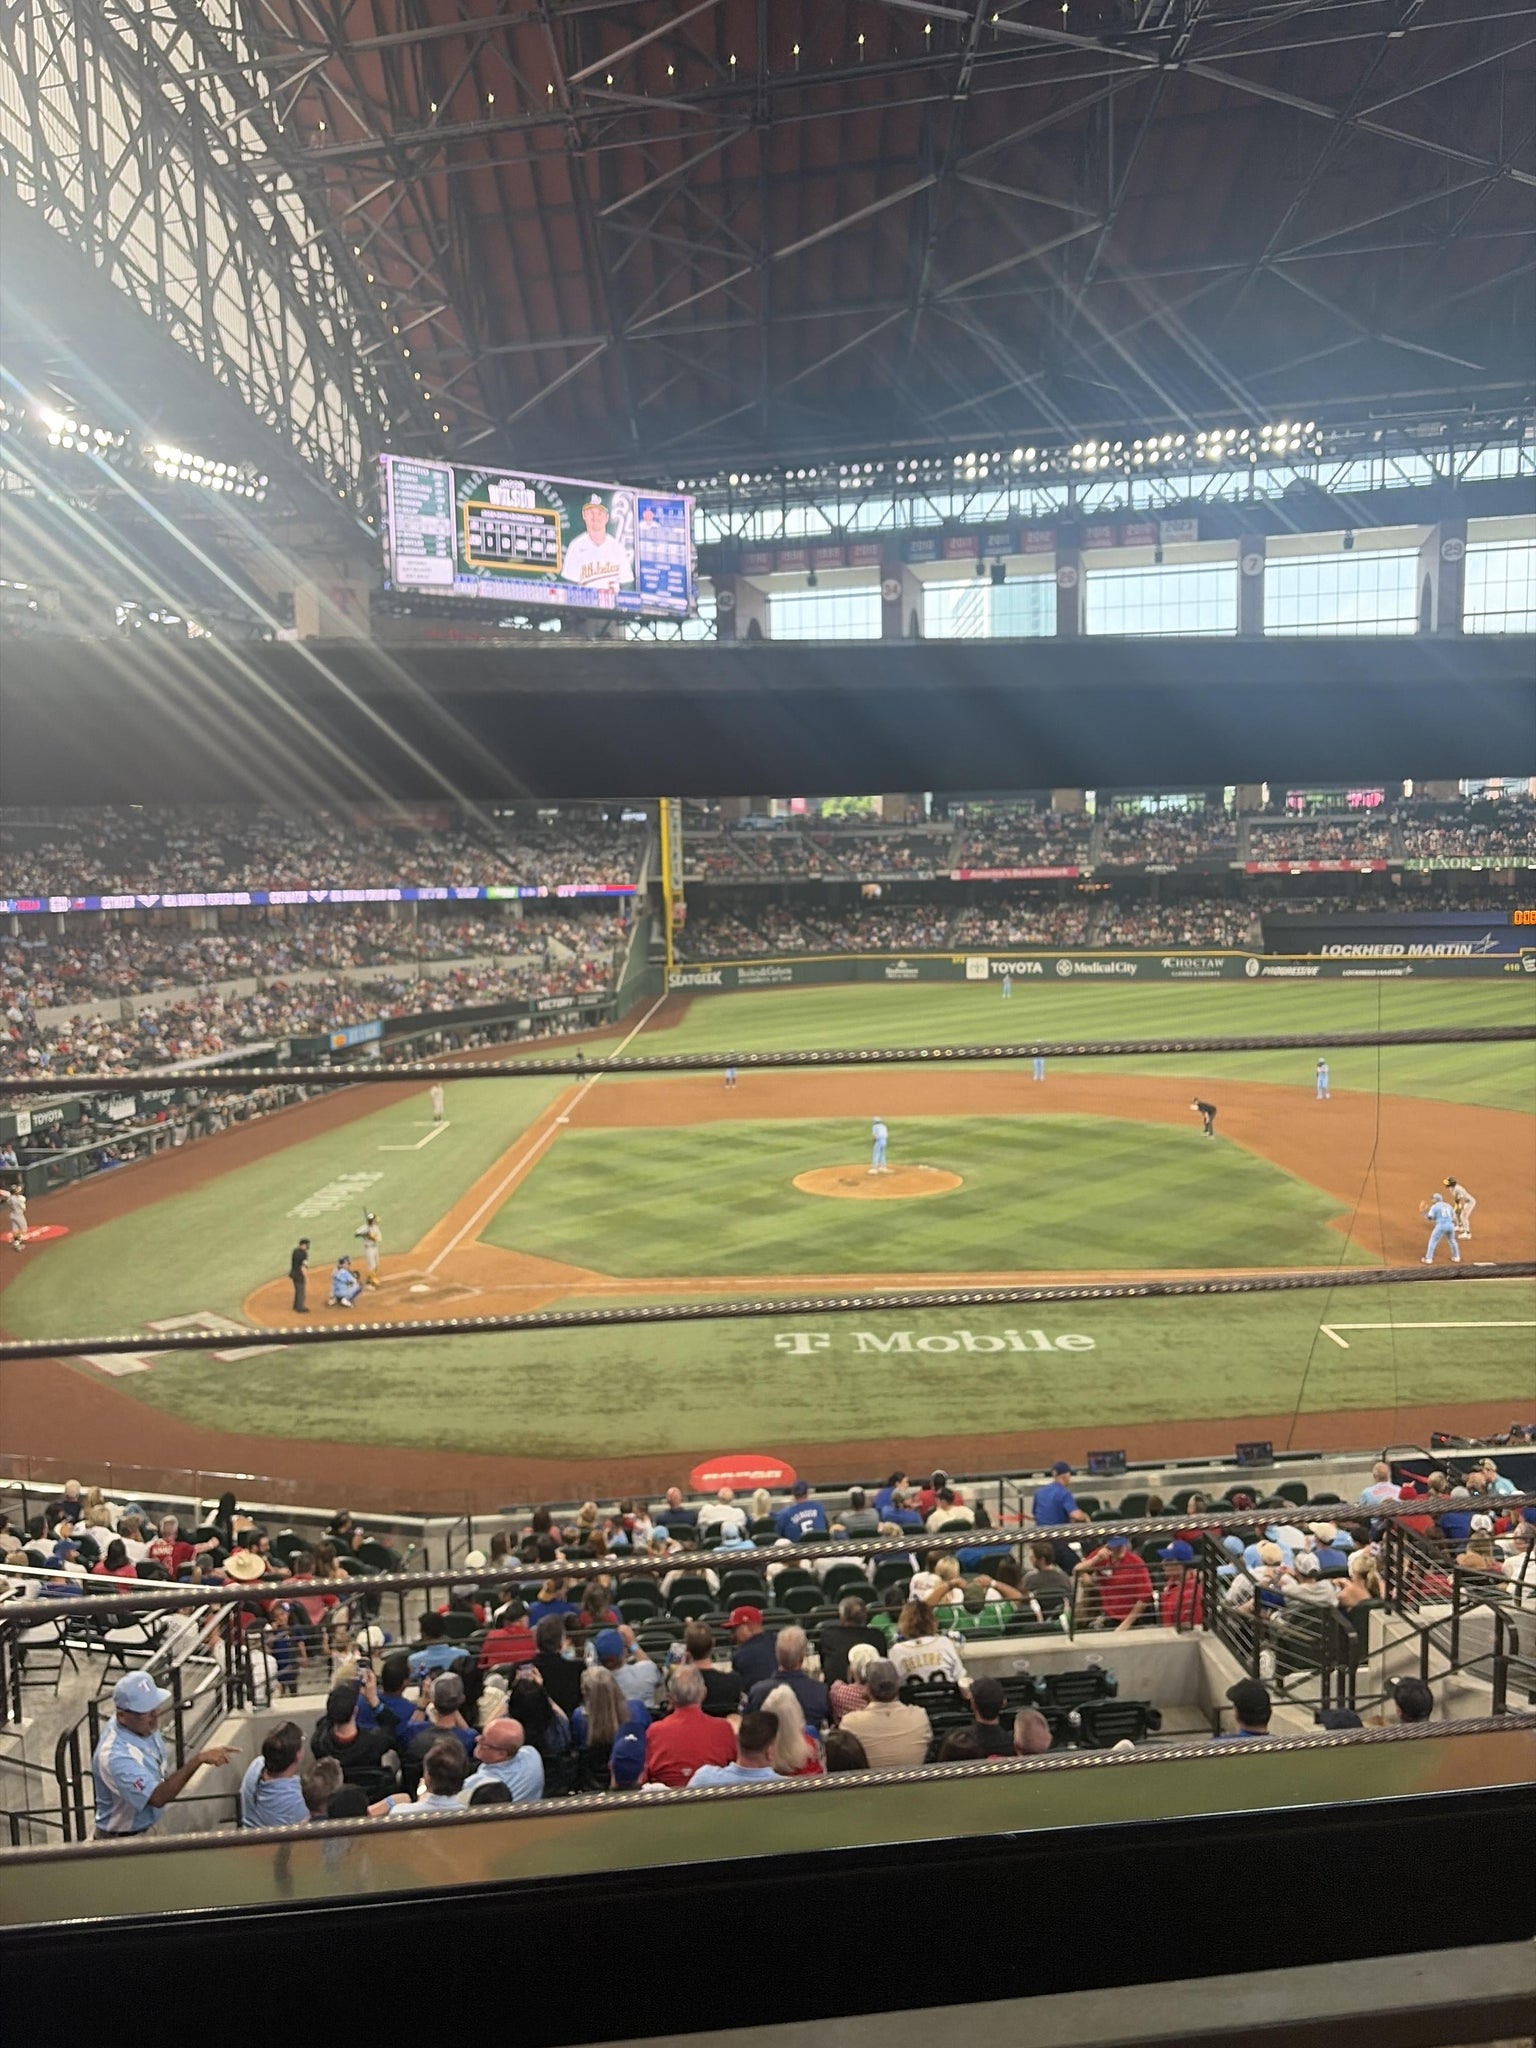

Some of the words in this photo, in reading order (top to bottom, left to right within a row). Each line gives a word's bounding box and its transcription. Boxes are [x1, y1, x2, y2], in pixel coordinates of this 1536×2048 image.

[1250, 559, 1258, 570] 7
[1418, 857, 1471, 870] LUXOR
[1321, 943, 1404, 956] LOCKHEED
[1408, 943, 1472, 956] MARTIN
[991, 961, 1043, 974] TOYOTA
[1074, 961, 1115, 974] Medical
[1116, 961, 1137, 976] City
[32, 1108, 64, 1127] TOYOTA
[849, 1329, 1097, 1353] Mobile
